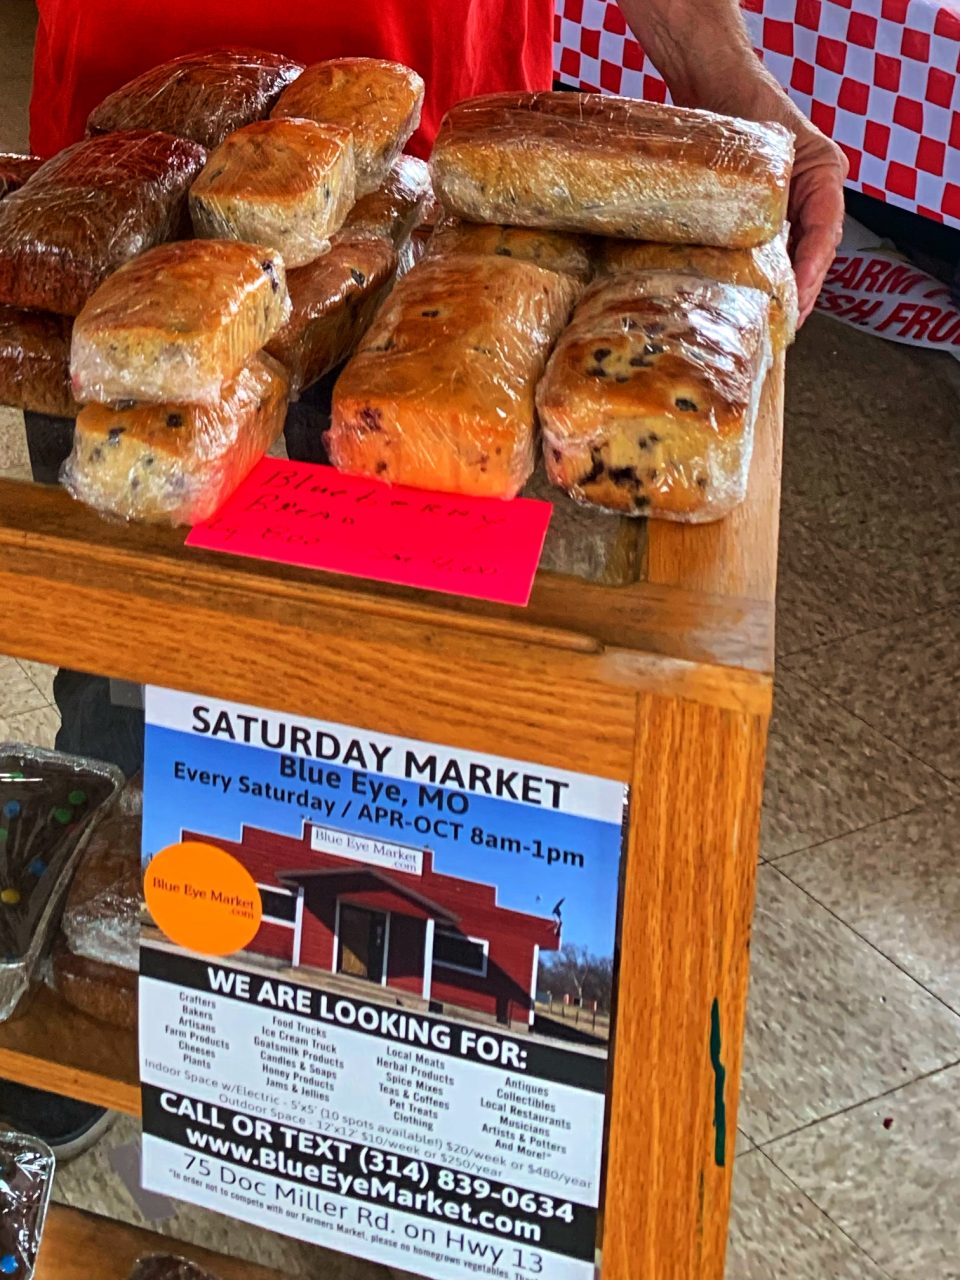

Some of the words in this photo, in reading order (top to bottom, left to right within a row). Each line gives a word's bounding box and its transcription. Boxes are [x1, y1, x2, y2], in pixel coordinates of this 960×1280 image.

[874, 302, 960, 345] FRU
[192, 705, 392, 773] SATURDAY
[405, 750, 569, 809] MARKET
[280, 755, 341, 789] Blue
[352, 770, 407, 807] Eye,
[418, 785, 470, 815] MO
[174, 761, 232, 793] Every
[239, 776, 336, 817] Saturday
[358, 804, 464, 841] APR-OCT
[470, 826, 585, 868] 8am-1pm
[315, 829, 343, 845] Blue
[347, 837, 369, 852] Eye
[373, 845, 417, 864] Market
[392, 861, 417, 872] .com
[153, 877, 180, 892] Blue
[184, 884, 207, 900] Eye
[211, 889, 254, 909] Market
[230, 907, 254, 920] .com
[179, 991, 216, 1009] Crafters
[182, 1004, 213, 1021] Bakers
[178, 1016, 216, 1033] Artisans
[208, 967, 250, 998] WE
[257, 981, 312, 1014] ARE
[320, 995, 451, 1050] LOOKING
[460, 1030, 528, 1069] FOR:
[272, 1015, 293, 1030] Food
[297, 1022, 327, 1039] Trucks
[165, 1025, 187, 1038] Farm
[190, 1031, 230, 1050] Products
[178, 1040, 216, 1058] Cheeses
[262, 1026, 276, 1038] Ice
[279, 1030, 308, 1046] Cream
[312, 1038, 337, 1054] Truck
[183, 1053, 211, 1069] Plants
[254, 1036, 299, 1057] Goatsmilk
[302, 1049, 344, 1069] Products
[260, 1050, 297, 1068] Candles
[300, 1060, 306, 1071] &
[309, 1064, 337, 1080] Soaps
[386, 1045, 412, 1060] Local
[416, 1053, 445, 1070] Meats
[262, 1064, 291, 1082] Honey
[293, 1072, 334, 1091] Products
[376, 1057, 407, 1073] Herbal
[411, 1065, 454, 1086] Products
[386, 1072, 412, 1087] Spice
[416, 1079, 443, 1096] Mixes
[266, 1077, 289, 1092] Jams
[291, 1083, 298, 1093] &
[301, 1085, 330, 1102] Jellies
[379, 1083, 400, 1097] Teas
[403, 1090, 410, 1099] &
[413, 1093, 450, 1110] Coffees
[497, 1089, 556, 1112] Collectibles
[505, 1077, 549, 1097] Antiques
[145, 1058, 181, 1077] Indoor
[184, 1069, 218, 1087] Space
[221, 1082, 280, 1105] w/Electric
[321, 1107, 340, 1122] (10
[343, 1113, 374, 1131] spots
[377, 1126, 443, 1149] available!)
[446, 1141, 507, 1166] $20/week
[511, 1161, 524, 1170] or
[389, 1099, 405, 1111] Pet
[409, 1103, 438, 1119] Treats
[393, 1111, 434, 1131] Clothing
[480, 1097, 507, 1112] Local
[510, 1104, 571, 1130] Restaurants
[219, 1093, 267, 1114] Outdoor
[270, 1107, 306, 1127] Space
[361, 1131, 420, 1155] $10/week
[424, 1149, 437, 1159] or
[440, 1153, 503, 1177] $250/year
[481, 1123, 515, 1140] Artists
[519, 1132, 526, 1143] &
[530, 1136, 567, 1154] Potters
[500, 1116, 550, 1137] Musicians
[160, 1092, 225, 1129] CALL
[232, 1115, 273, 1143] OR
[280, 1126, 352, 1163] TEXT
[359, 1147, 429, 1188] (314)
[438, 1169, 574, 1223] 839-0634
[495, 1139, 514, 1151] And
[186, 1128, 540, 1241] www.BlueEyeMarket.com
[183, 1152, 211, 1176] 75
[220, 1166, 266, 1196] Doc
[275, 1183, 348, 1220] Miller
[357, 1206, 395, 1234] Rd.
[404, 1223, 435, 1244] on
[446, 1230, 503, 1264] Hwy
[512, 1247, 543, 1273] 13
[183, 1174, 203, 1187] order
[205, 1181, 218, 1193] not
[220, 1186, 228, 1195] to
[230, 1191, 264, 1209] compete
[267, 1199, 283, 1214] with
[285, 1208, 298, 1218] our
[301, 1213, 333, 1230] Farmers
[370, 1234, 398, 1249] please
[413, 1245, 461, 1265] homegrown
